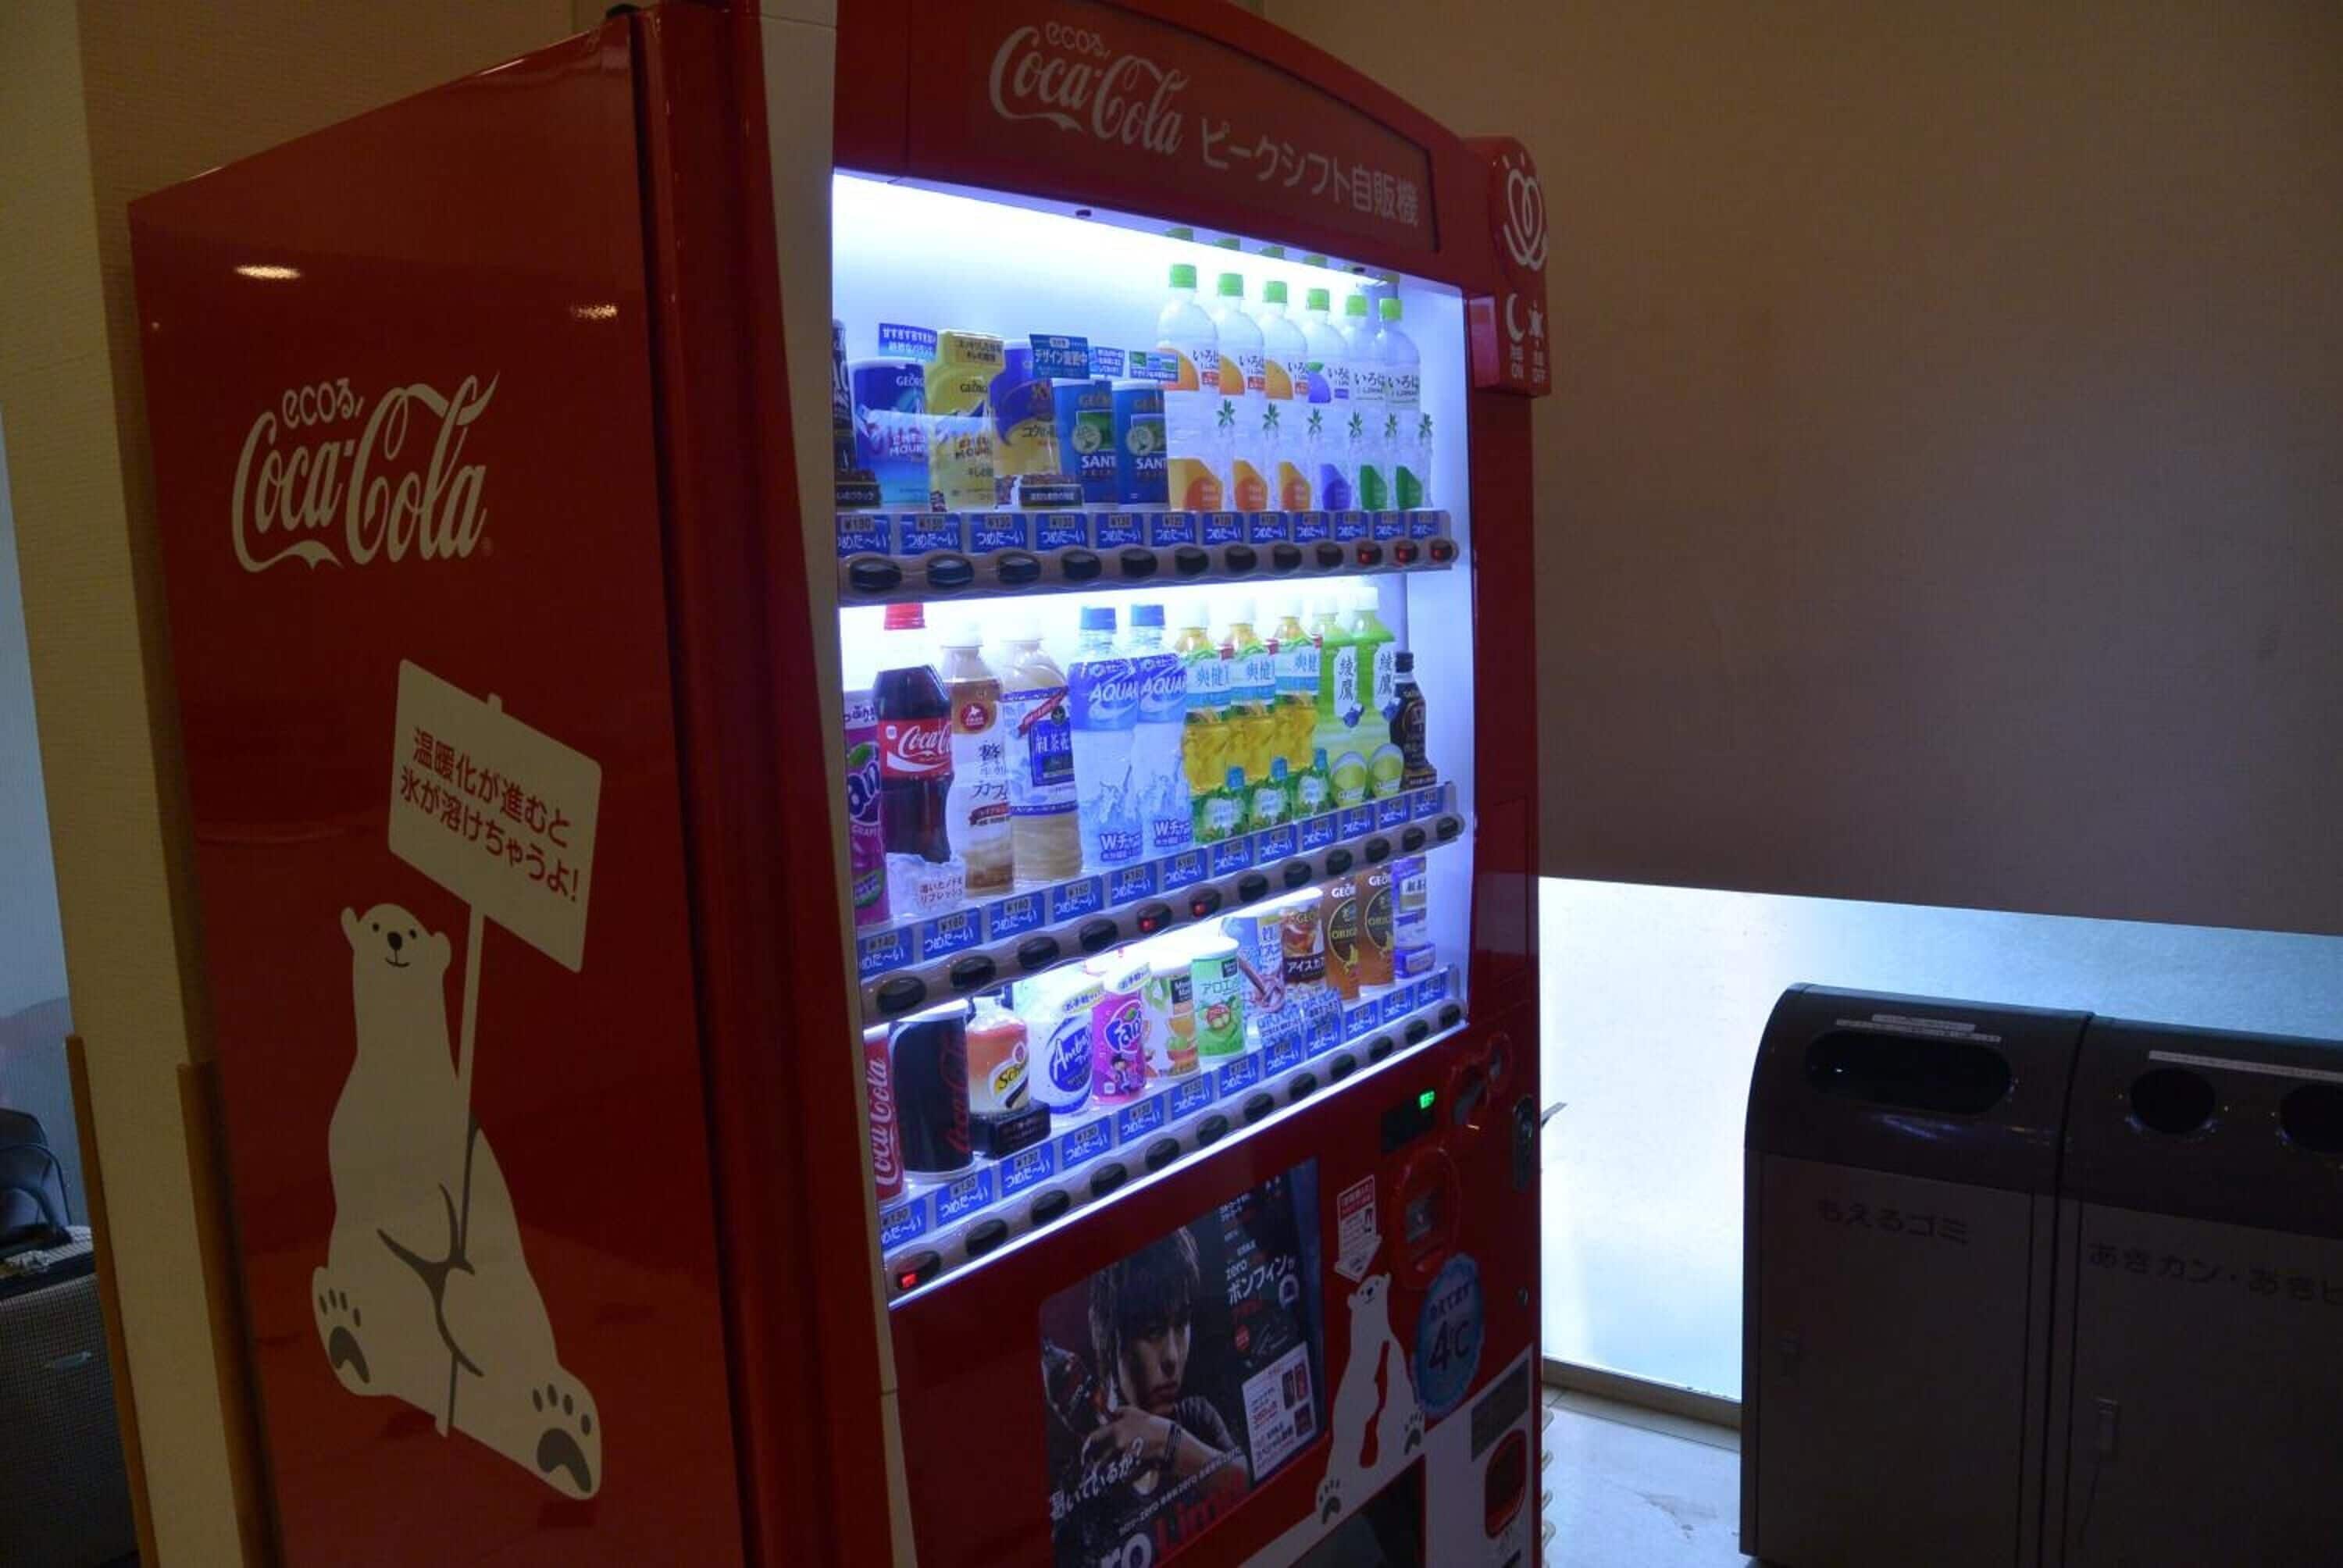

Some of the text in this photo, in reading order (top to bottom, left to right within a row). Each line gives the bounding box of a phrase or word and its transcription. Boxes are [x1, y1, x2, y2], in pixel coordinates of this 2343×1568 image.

[990, 24, 1190, 155] Coca-Cola
[1201, 116, 1420, 228] ピークシフト自販機
[232, 370, 501, 573] Coca-Cola
[412, 725, 571, 849] 温暖化が進むと
[865, 1058, 902, 1185] Coca-Cola
